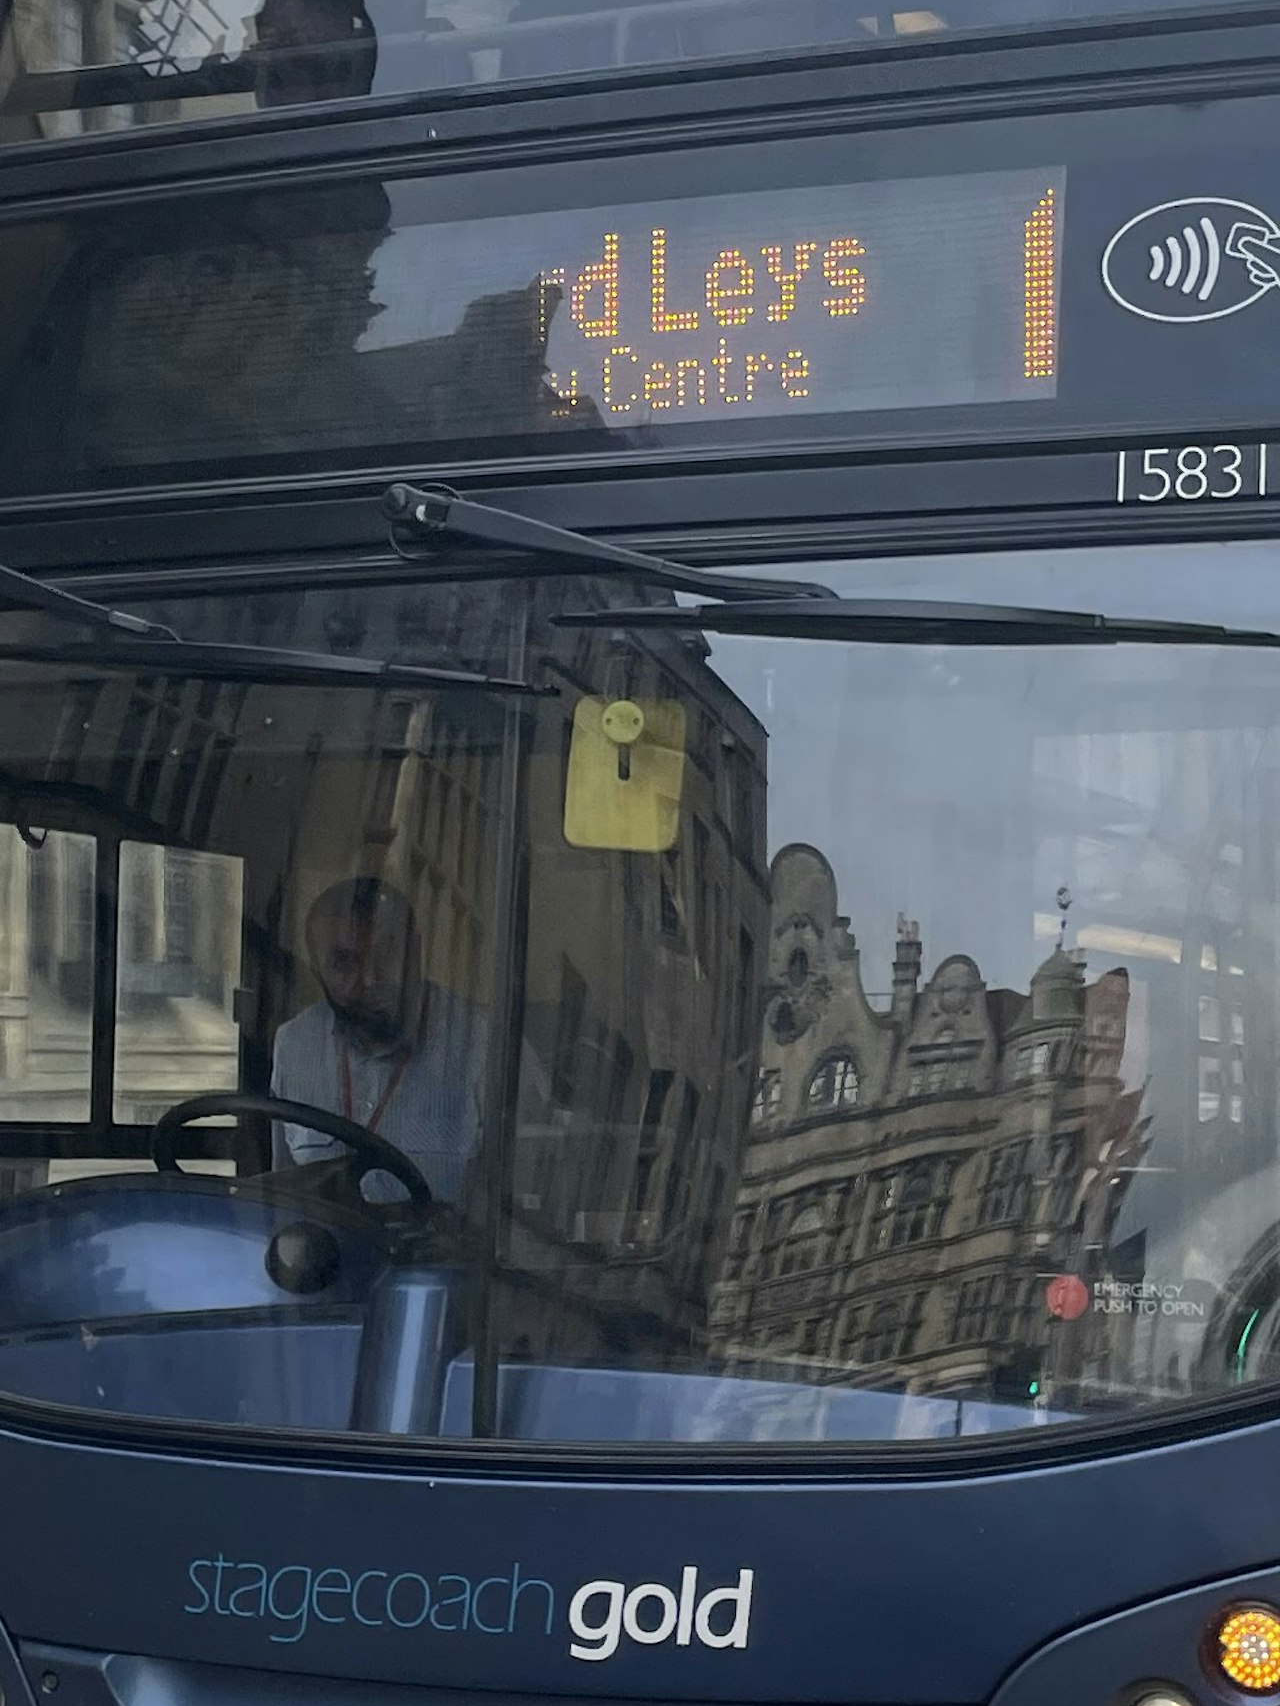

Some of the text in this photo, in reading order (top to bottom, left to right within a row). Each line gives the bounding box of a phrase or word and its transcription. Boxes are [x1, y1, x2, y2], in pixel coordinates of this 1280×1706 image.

[651, 227, 866, 333] Leys
[1024, 185, 1057, 379] 1
[602, 337, 811, 411] Centre
[1117, 444, 1267, 504] 15831
[1094, 1282, 1183, 1299] EMERGENCY
[1094, 1298, 1204, 1316] PUSH TO OPEN
[184, 1552, 754, 1662] stagecoach gold
